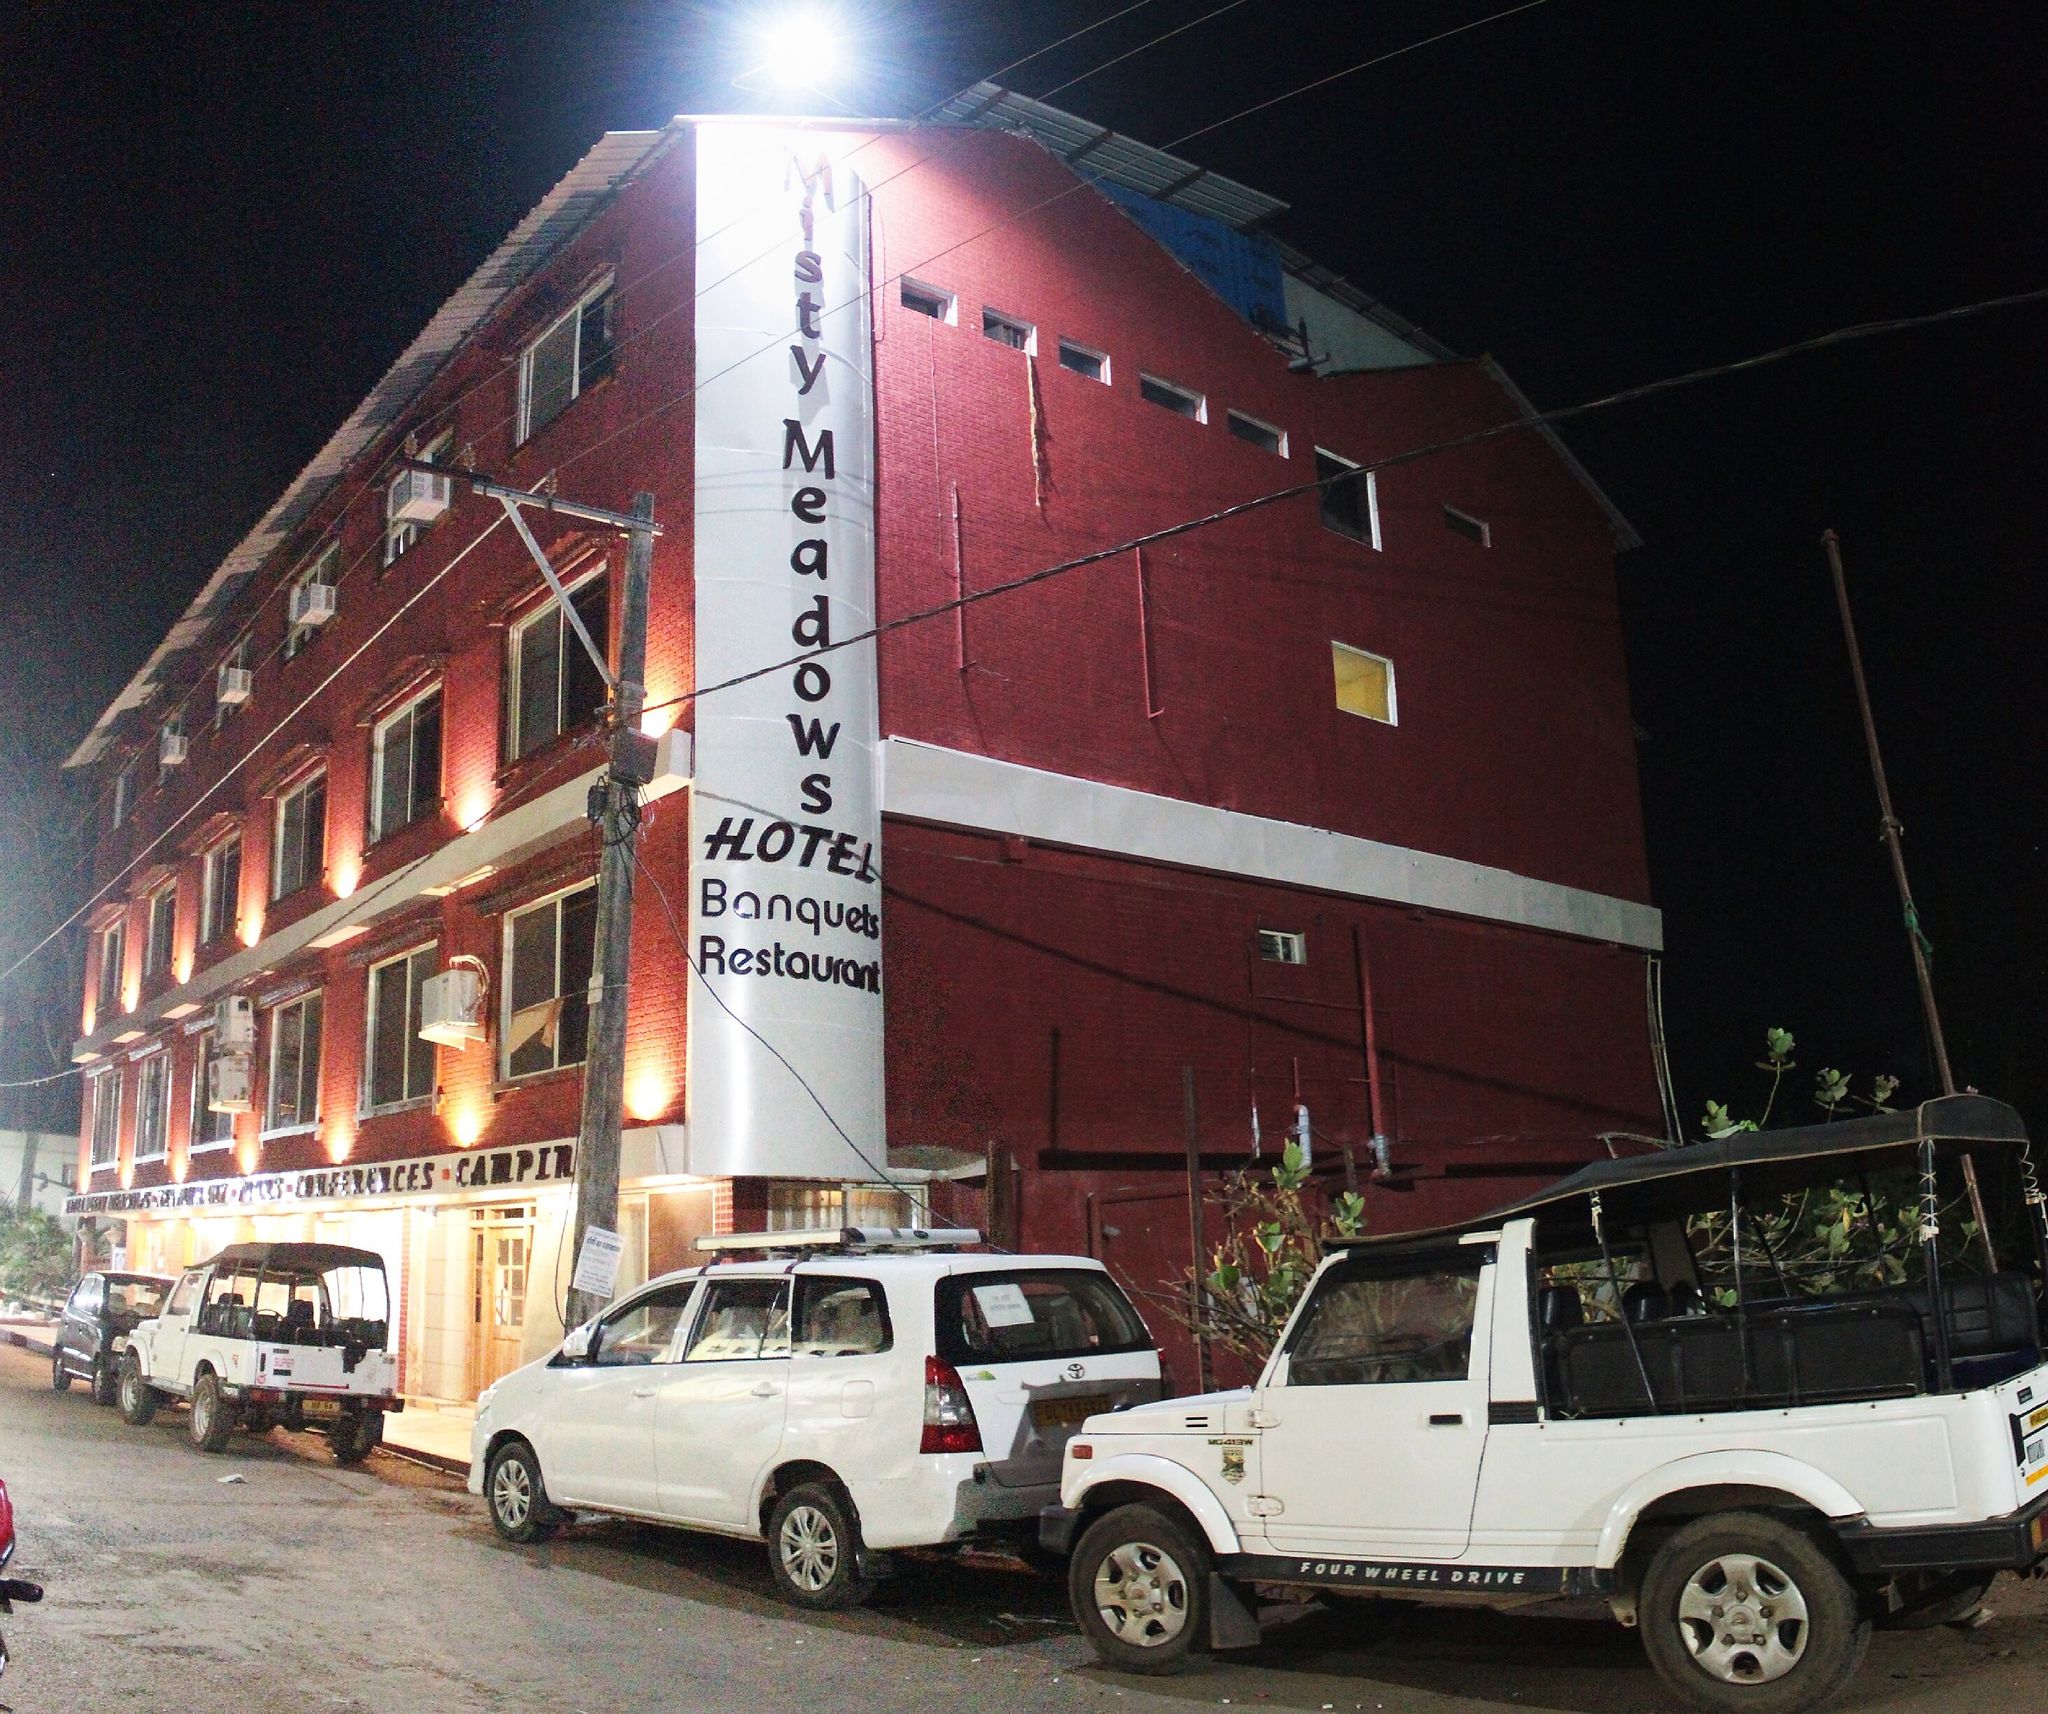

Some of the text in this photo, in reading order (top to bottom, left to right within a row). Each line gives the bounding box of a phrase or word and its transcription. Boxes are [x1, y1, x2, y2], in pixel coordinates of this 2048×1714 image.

[782, 145, 841, 815] Misty Meadows
[703, 816, 877, 884] HOTEL
[701, 878, 880, 940] Banquets
[699, 935, 881, 994] Restaurant
[455, 1144, 575, 1188] CAMPIN
[1299, 1561, 1526, 1586] FOUR WHEEL DRIVE
